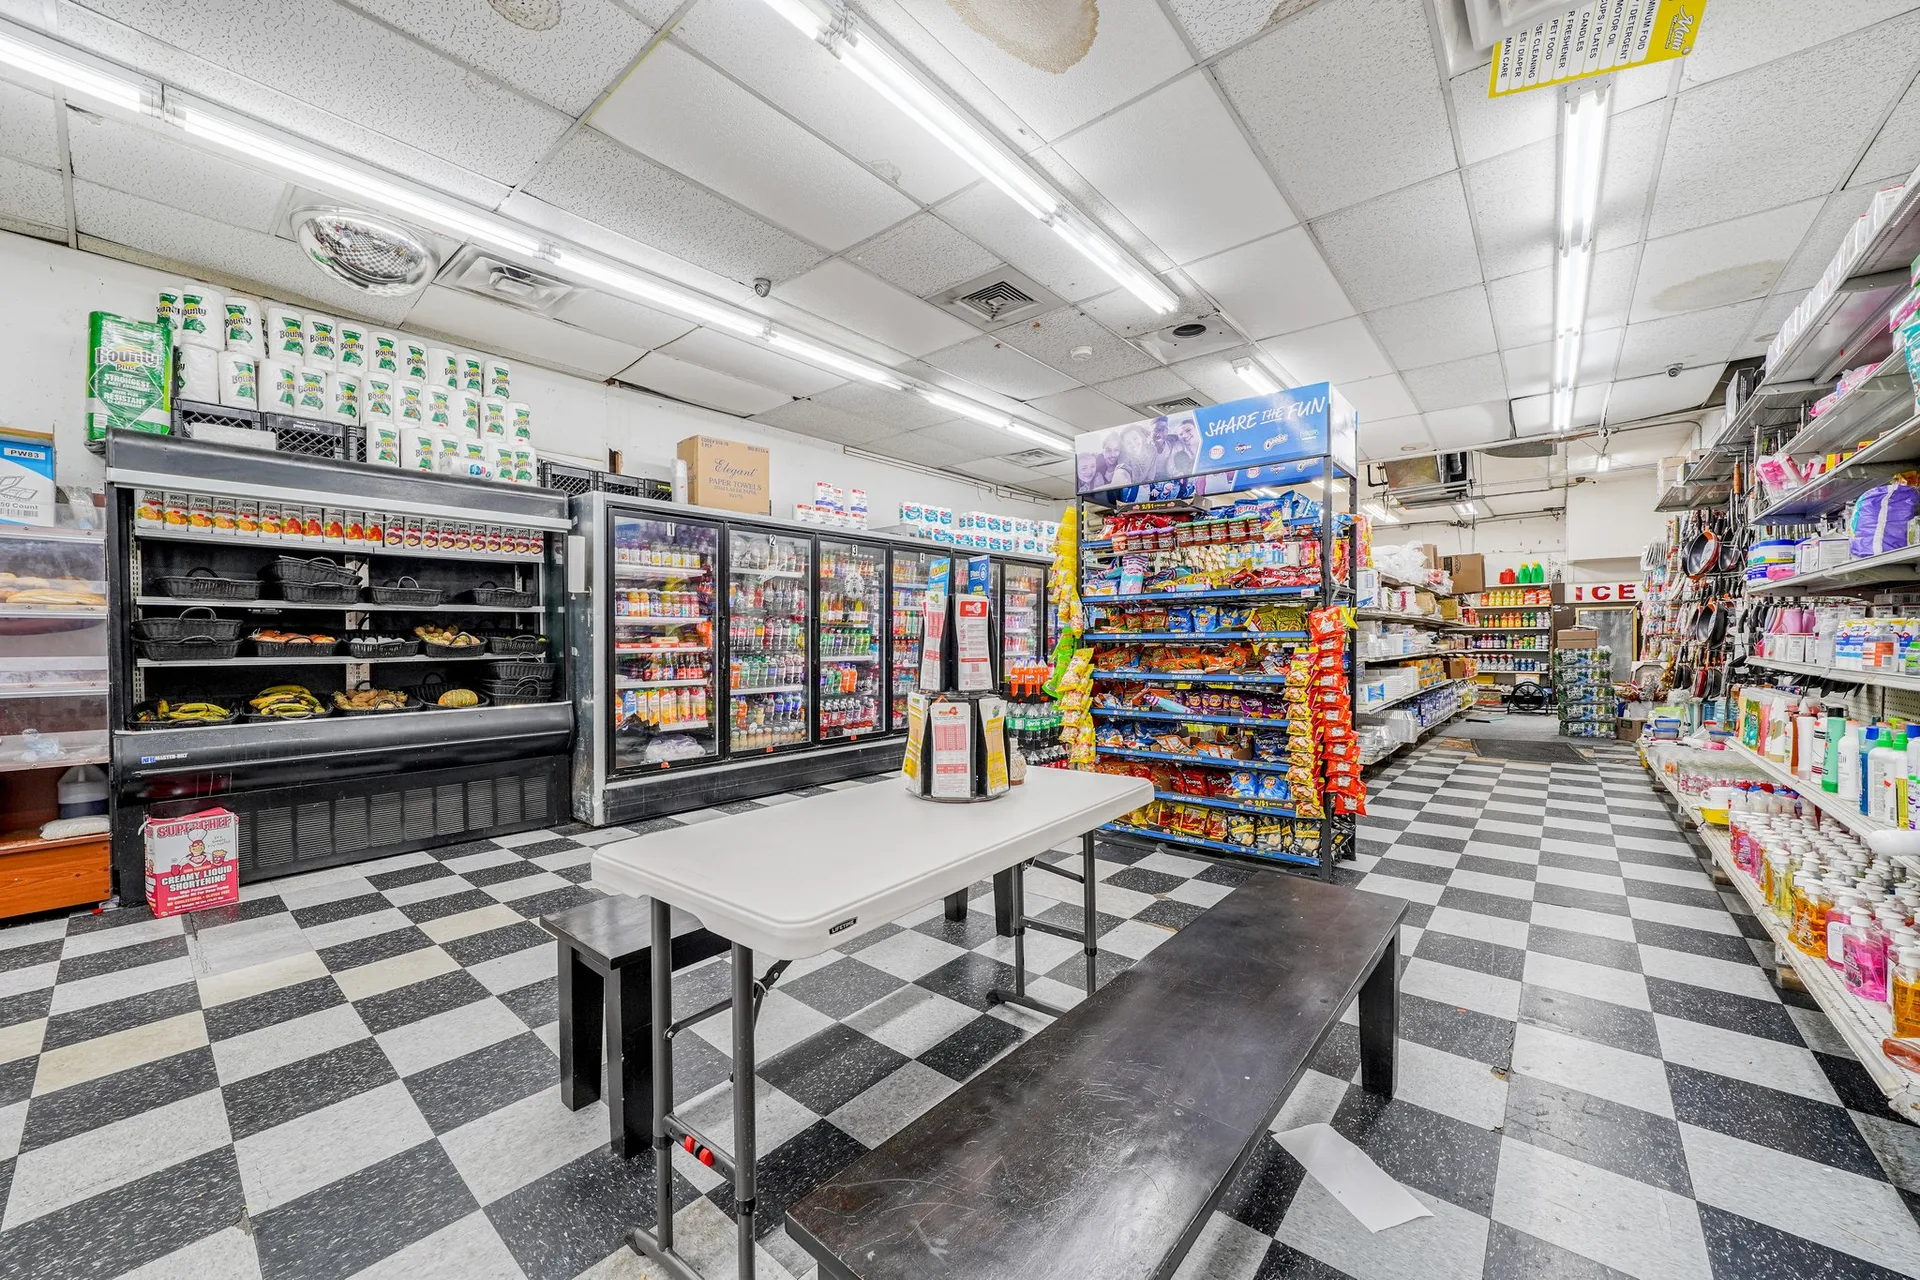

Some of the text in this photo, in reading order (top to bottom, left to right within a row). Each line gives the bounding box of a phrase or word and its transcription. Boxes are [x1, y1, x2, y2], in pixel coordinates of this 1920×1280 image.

[1576, 12, 1590, 52] CANDLES
[1606, 0, 1622, 48] MOTOR OIL
[1620, 9, 1638, 60] DETERGENT
[1669, 5, 1695, 52] Main
[1546, 19, 1558, 60] PET FOOD
[1558, 19, 1574, 68] FRESHENER
[1590, 26, 1602, 58] PLATES
[1500, 57, 1510, 78] CARE
[1514, 48, 1524, 78] DIAPER
[1528, 38, 1540, 78] CLEANING
[95, 346, 160, 369] Bounty
[1204, 396, 1326, 437] SHARE THE FUN
[10, 450, 40, 458] PW83
[714, 458, 756, 479] Elegant
[708, 477, 762, 491] PAPER TOWELS
[1575, 584, 1636, 601] ICE
[157, 816, 232, 838] SUPERCHEF
[162, 871, 200, 886] CREAMY
[203, 865, 232, 878] LIQUID
[170, 874, 226, 892] SHORTENING
[831, 920, 854, 934] LIFETIME
